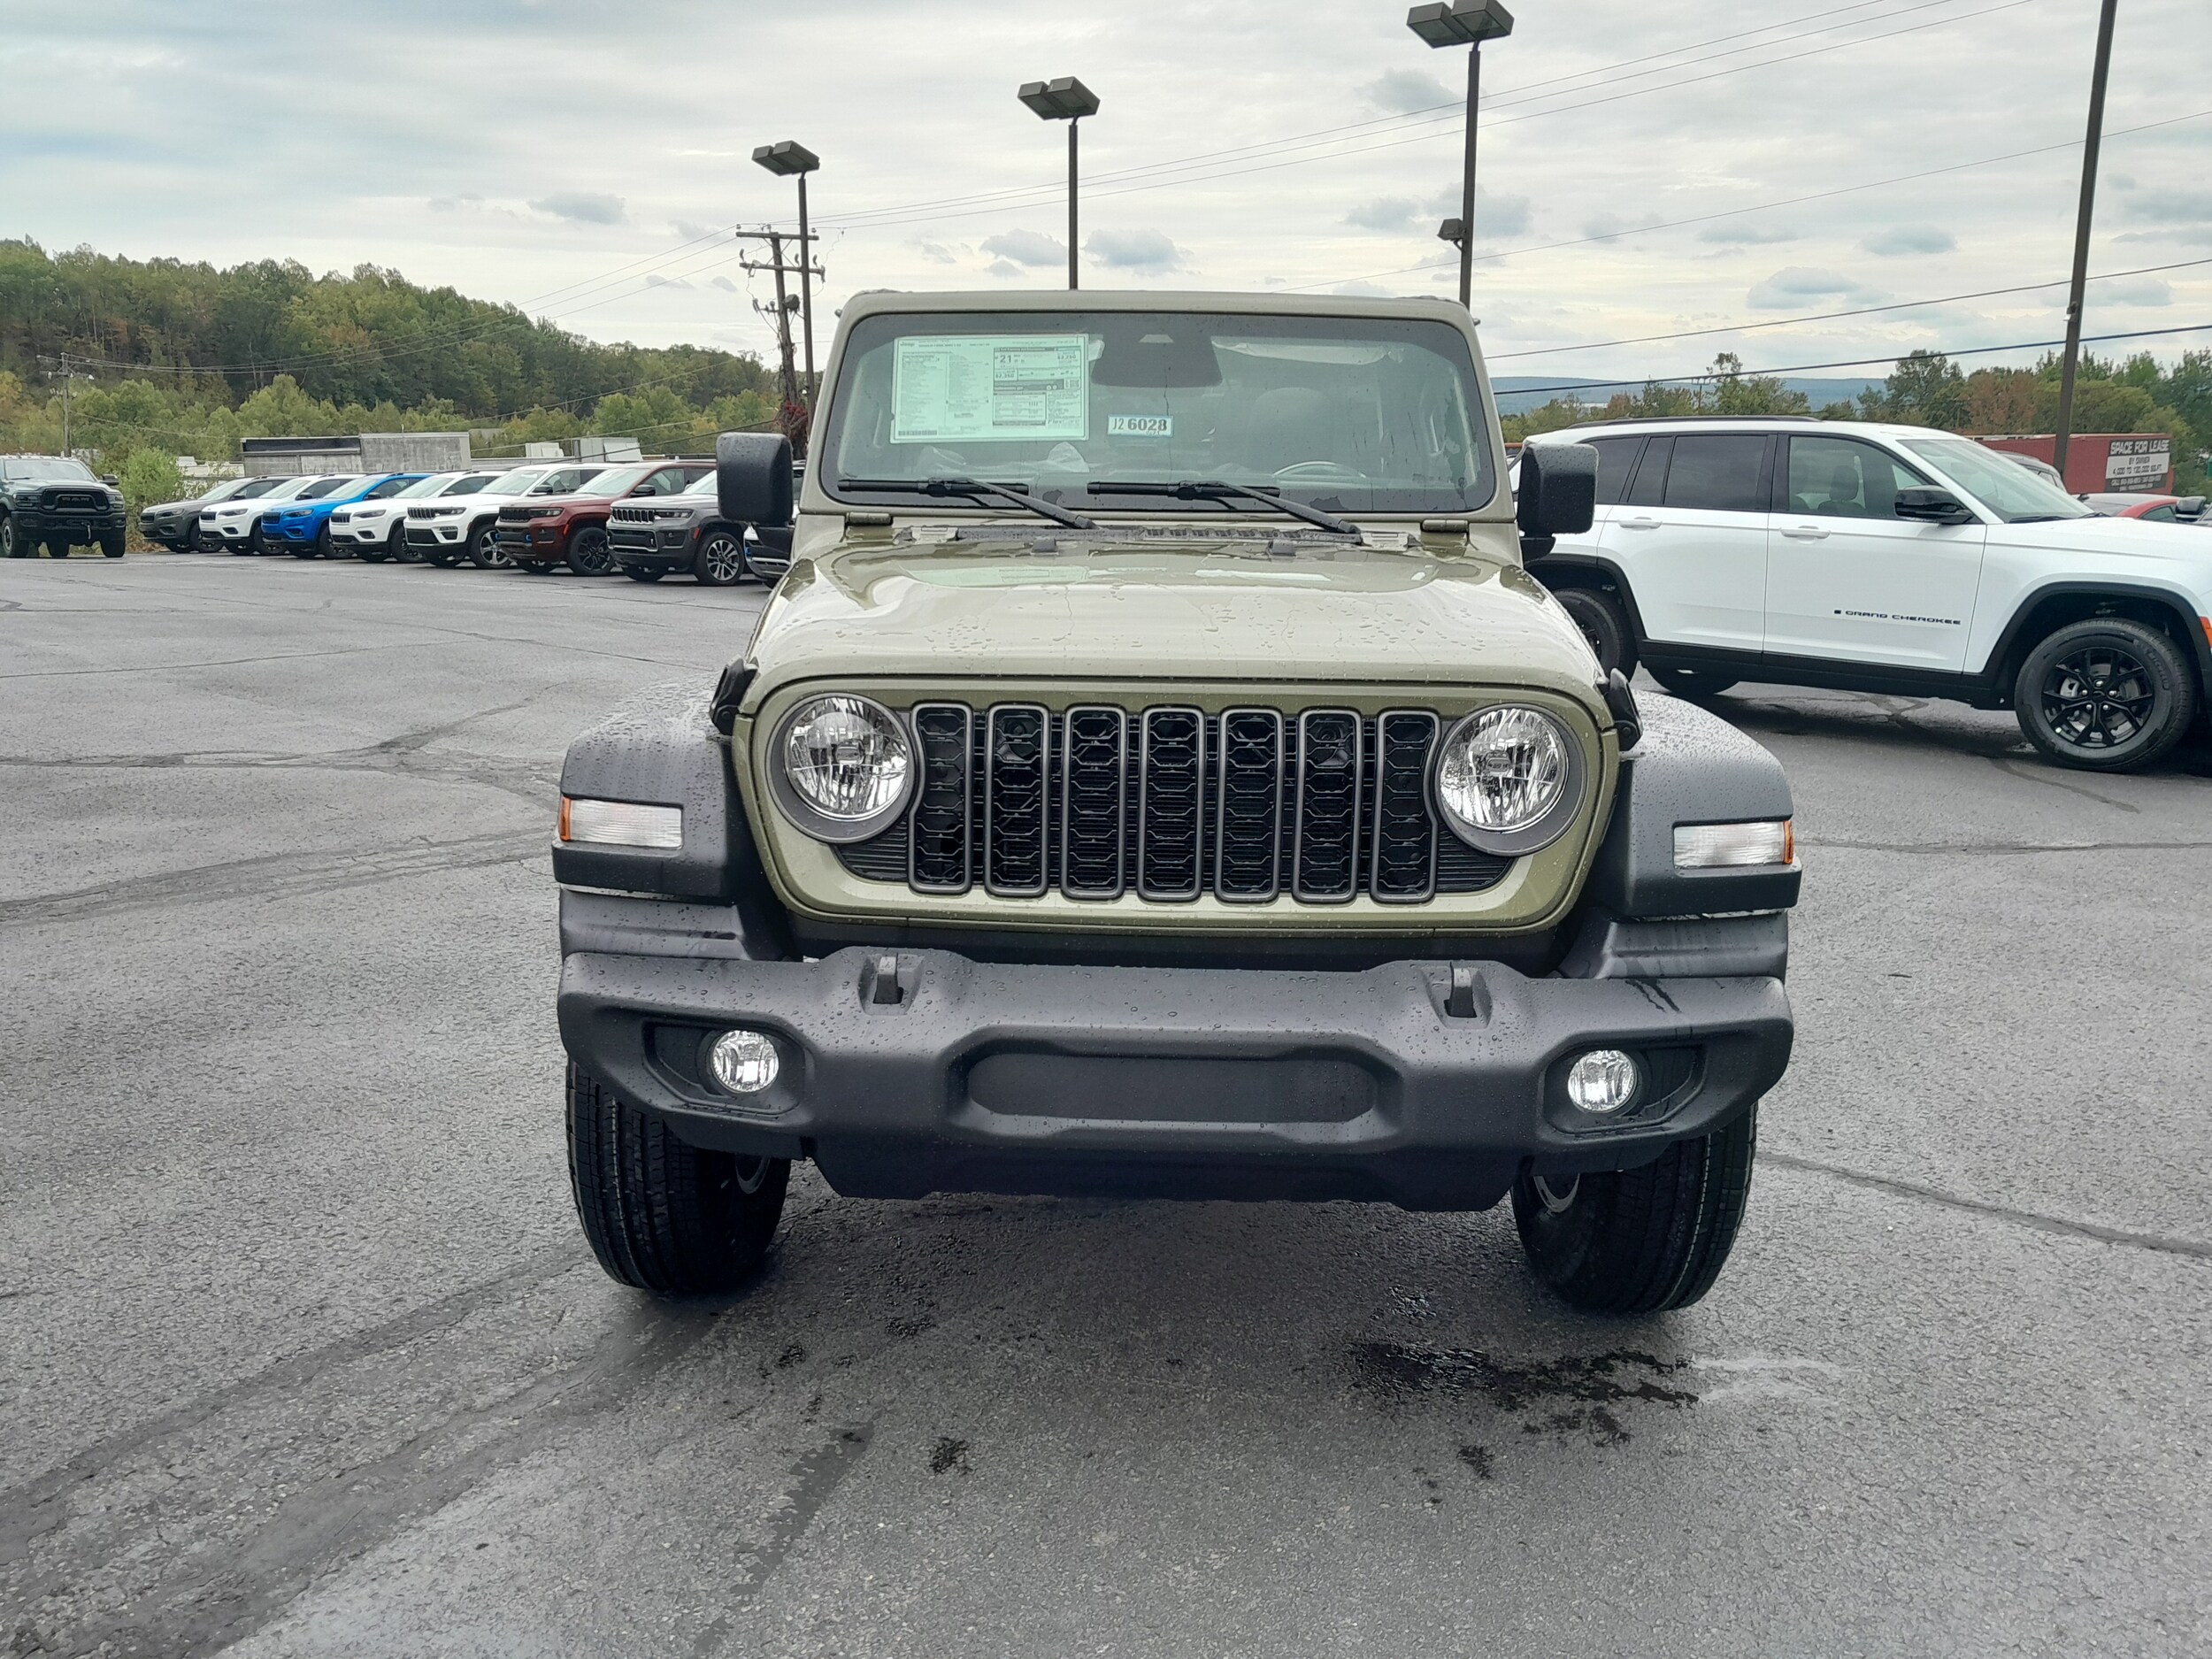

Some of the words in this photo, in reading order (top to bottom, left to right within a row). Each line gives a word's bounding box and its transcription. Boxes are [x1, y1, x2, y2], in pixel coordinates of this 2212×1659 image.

[1000, 354, 1012, 364] 21
[1127, 418, 1167, 431] 6028
[2110, 441, 2133, 455] SPACE
[2134, 440, 2148, 454] FOR
[2149, 439, 2170, 452] LEASE
[1892, 614, 1961, 625] CHEROKEE
